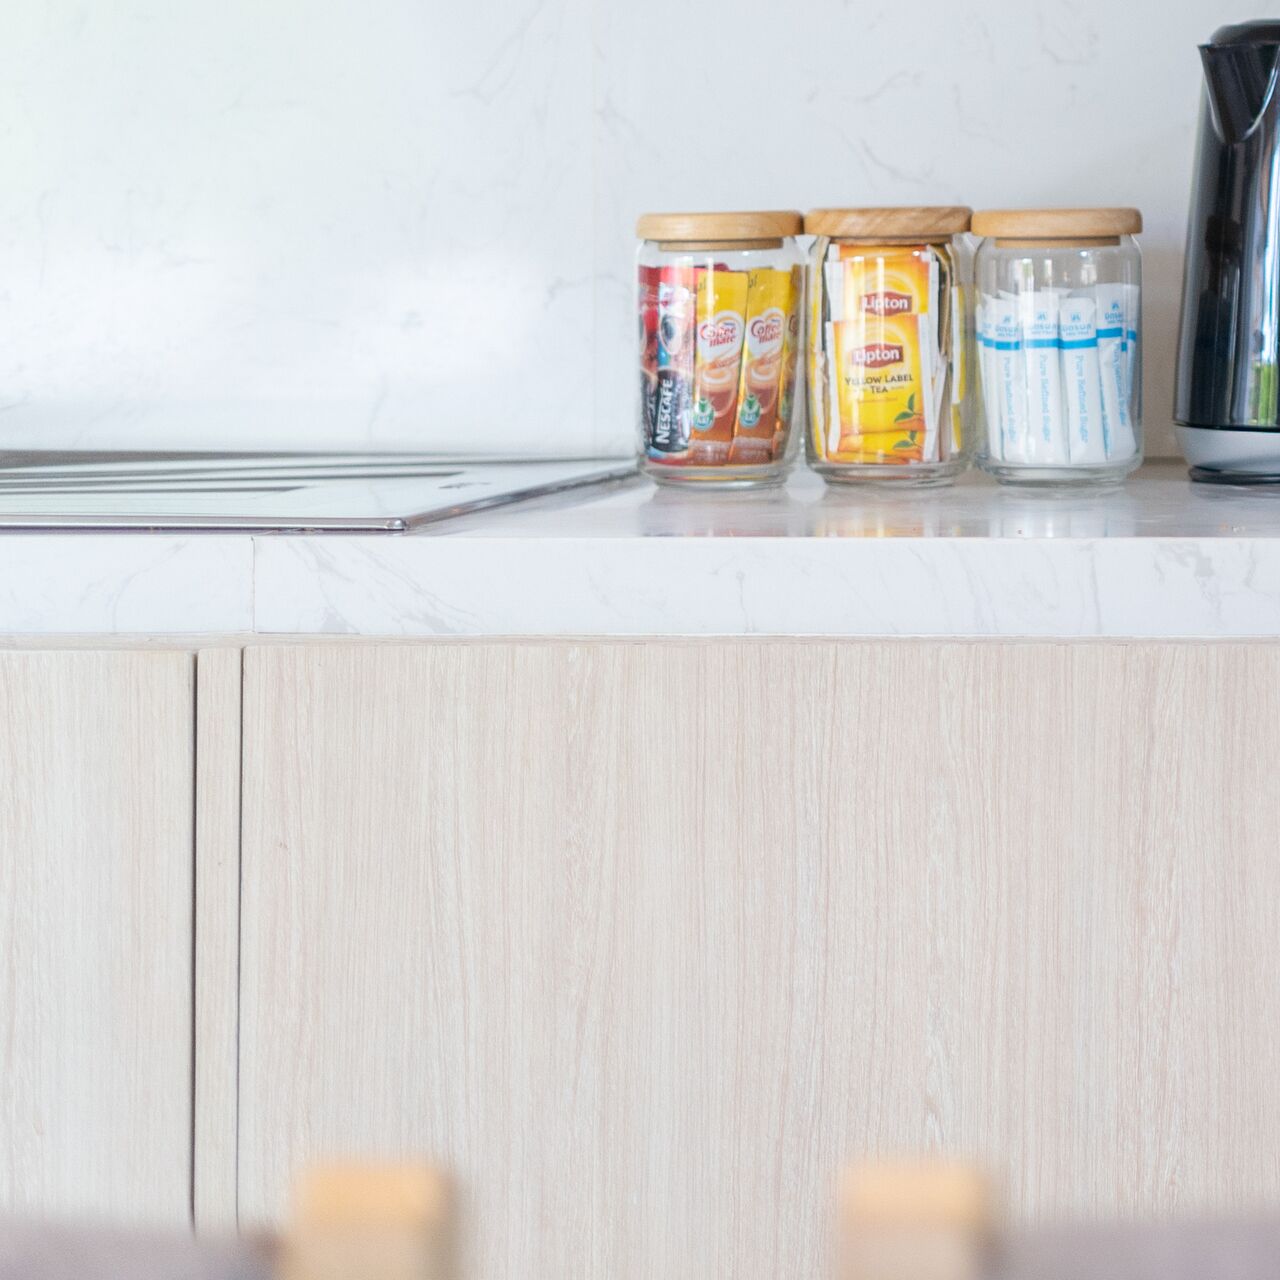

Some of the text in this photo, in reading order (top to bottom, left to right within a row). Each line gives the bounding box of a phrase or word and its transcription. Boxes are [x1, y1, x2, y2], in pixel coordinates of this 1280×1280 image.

[861, 296, 908, 312] Lipton
[853, 348, 901, 365] Lipton
[845, 373, 914, 386] YELLOW LABEL
[870, 385, 888, 394] TEA
